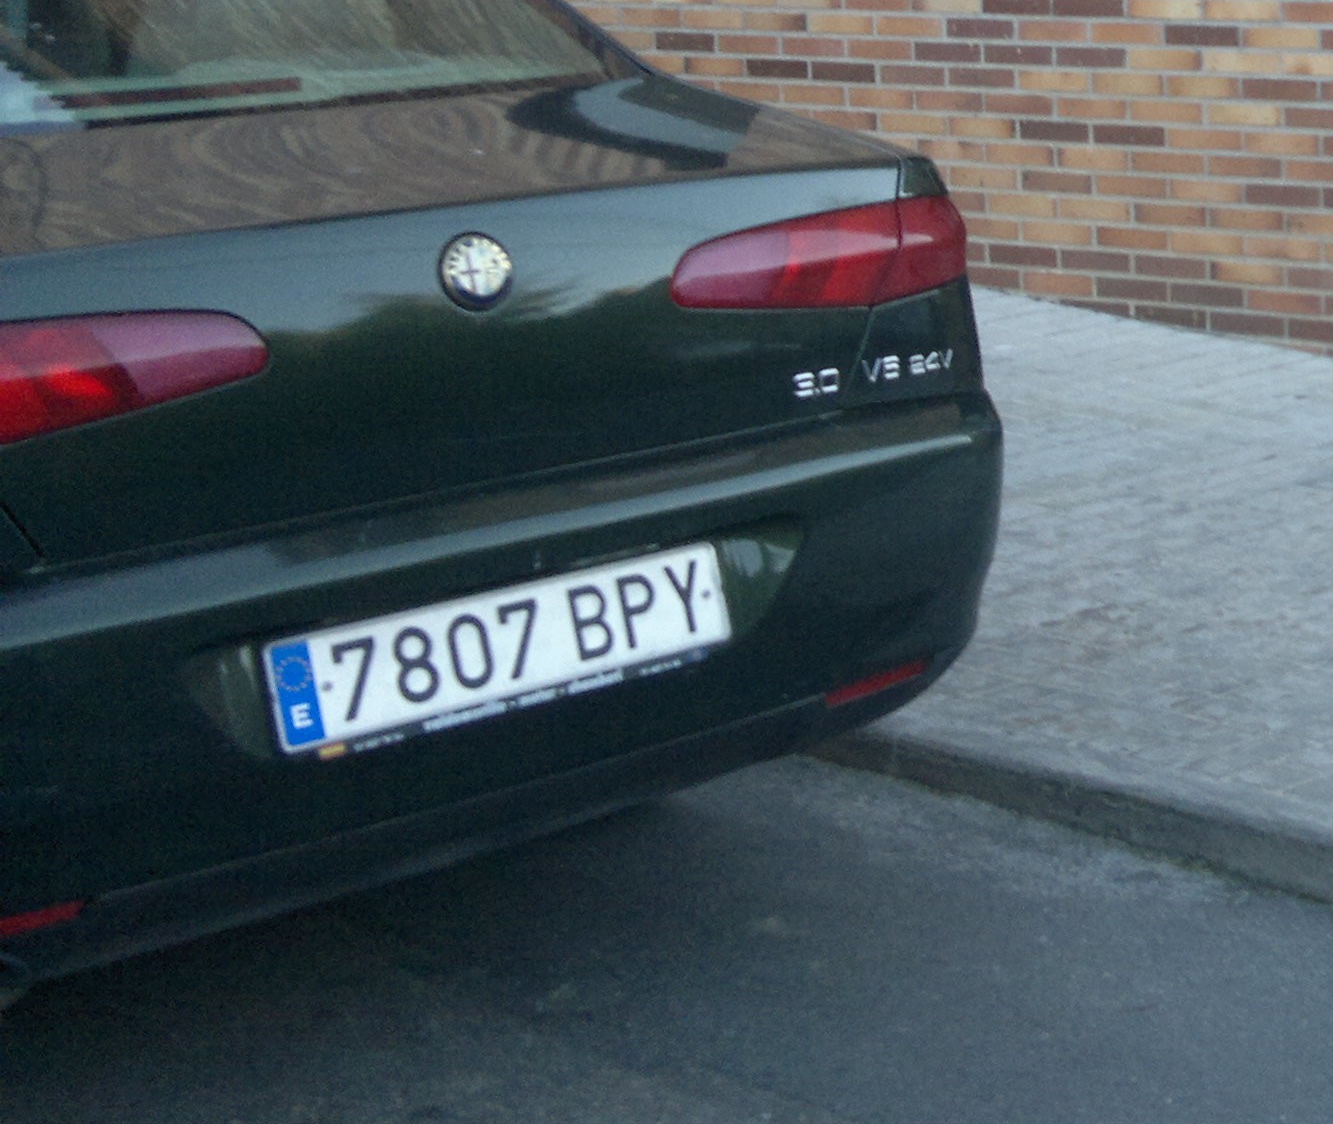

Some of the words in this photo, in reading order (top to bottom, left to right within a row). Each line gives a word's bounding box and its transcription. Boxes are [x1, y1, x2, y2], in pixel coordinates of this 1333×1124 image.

[331, 598, 536, 723] 7807
[567, 559, 698, 663] BPY
[290, 702, 314, 729] E
